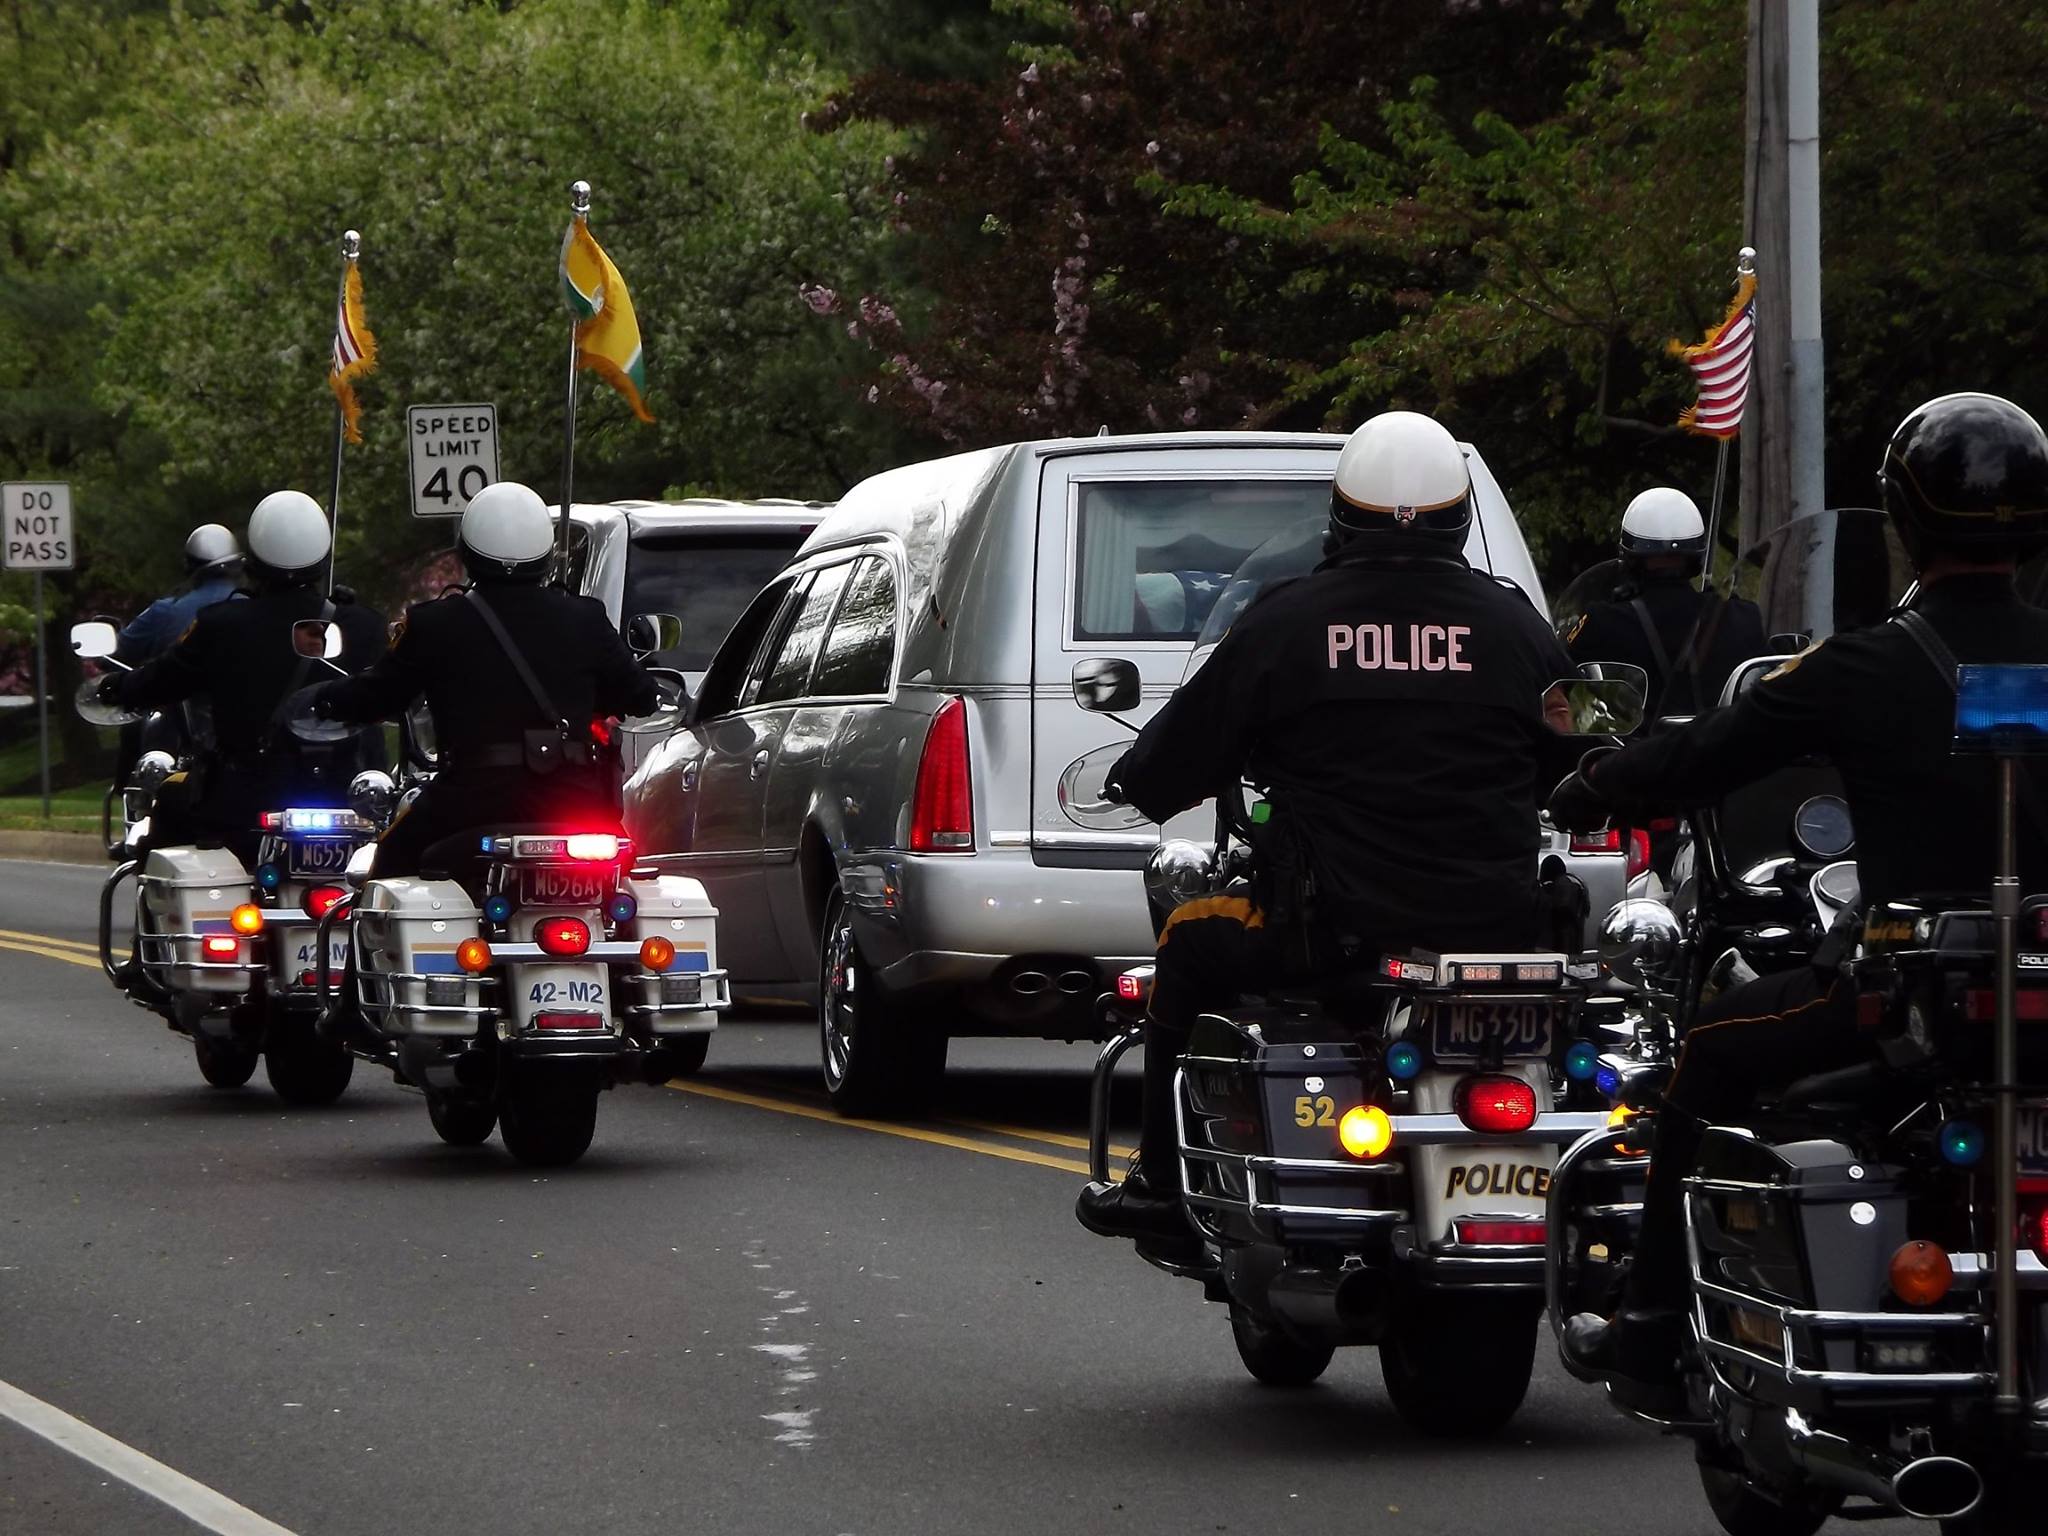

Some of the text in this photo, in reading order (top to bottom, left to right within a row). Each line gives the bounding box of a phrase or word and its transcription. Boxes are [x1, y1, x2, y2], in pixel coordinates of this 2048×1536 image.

[415, 416, 491, 435] SPEED
[425, 440, 481, 457] LIMIT
[422, 464, 489, 505] 40
[22, 491, 52, 510] DO
[15, 516, 60, 536] NOT
[9, 541, 67, 560] PASS
[1327, 624, 1473, 671] POLICE
[529, 981, 604, 1005] 42-M2
[1295, 1096, 1336, 1127] 52
[1445, 1163, 1551, 1200] POLICE
